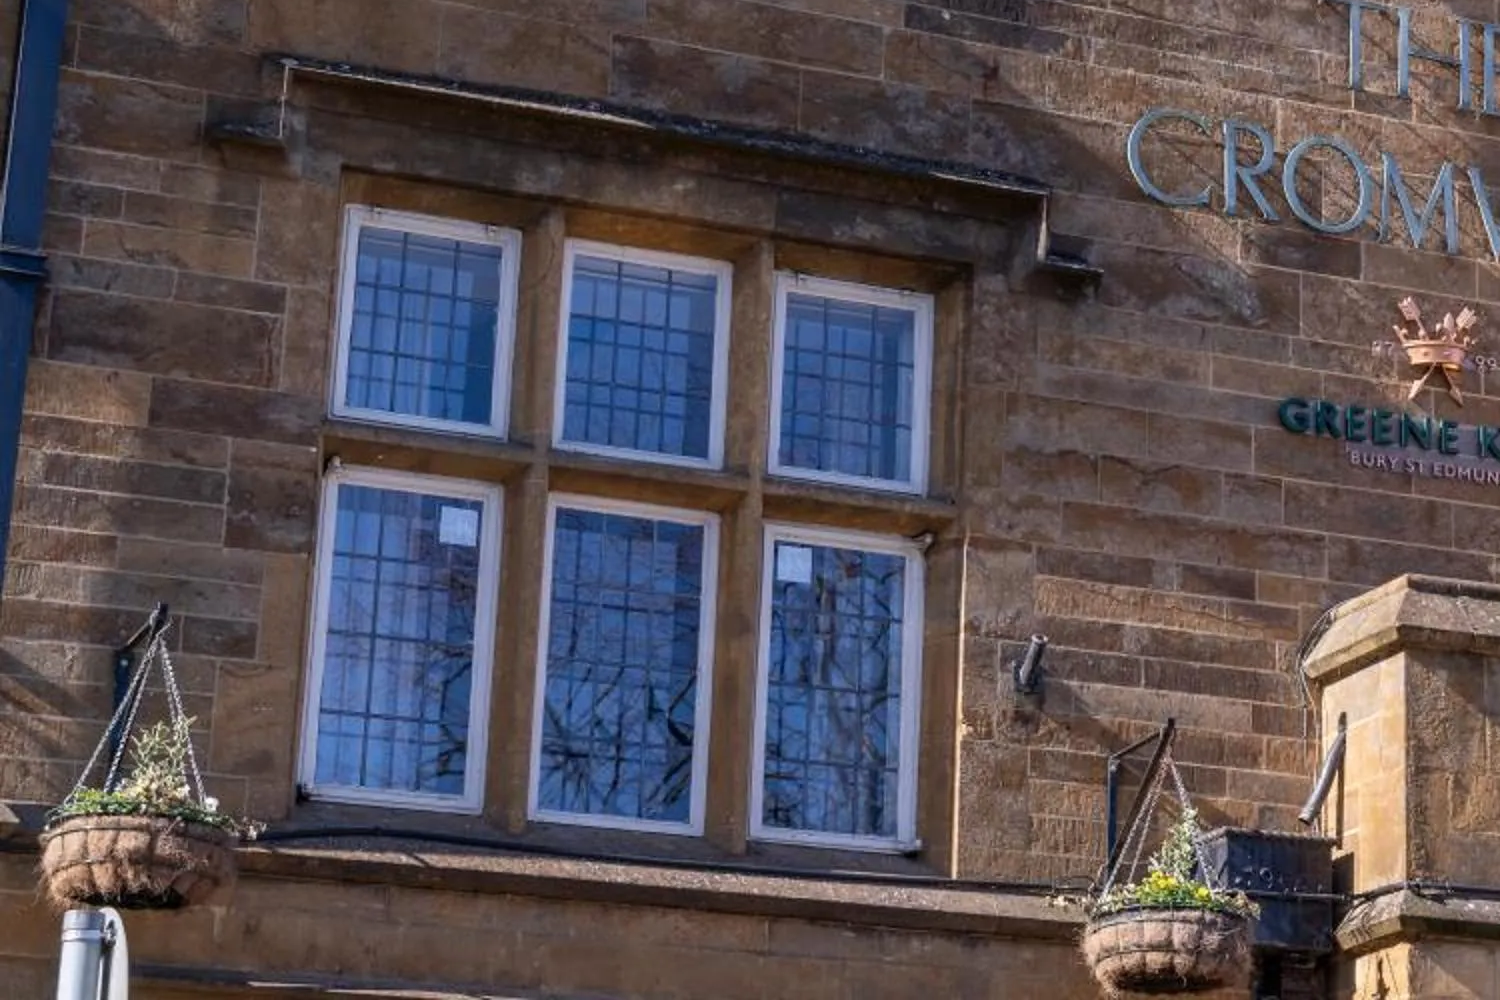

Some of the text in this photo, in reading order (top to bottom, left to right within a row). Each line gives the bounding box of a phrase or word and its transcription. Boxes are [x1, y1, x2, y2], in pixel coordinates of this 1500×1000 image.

[1279, 397, 1460, 456] GREENE
[1350, 450, 1400, 472] BURY
[1404, 457, 1426, 475] ST
